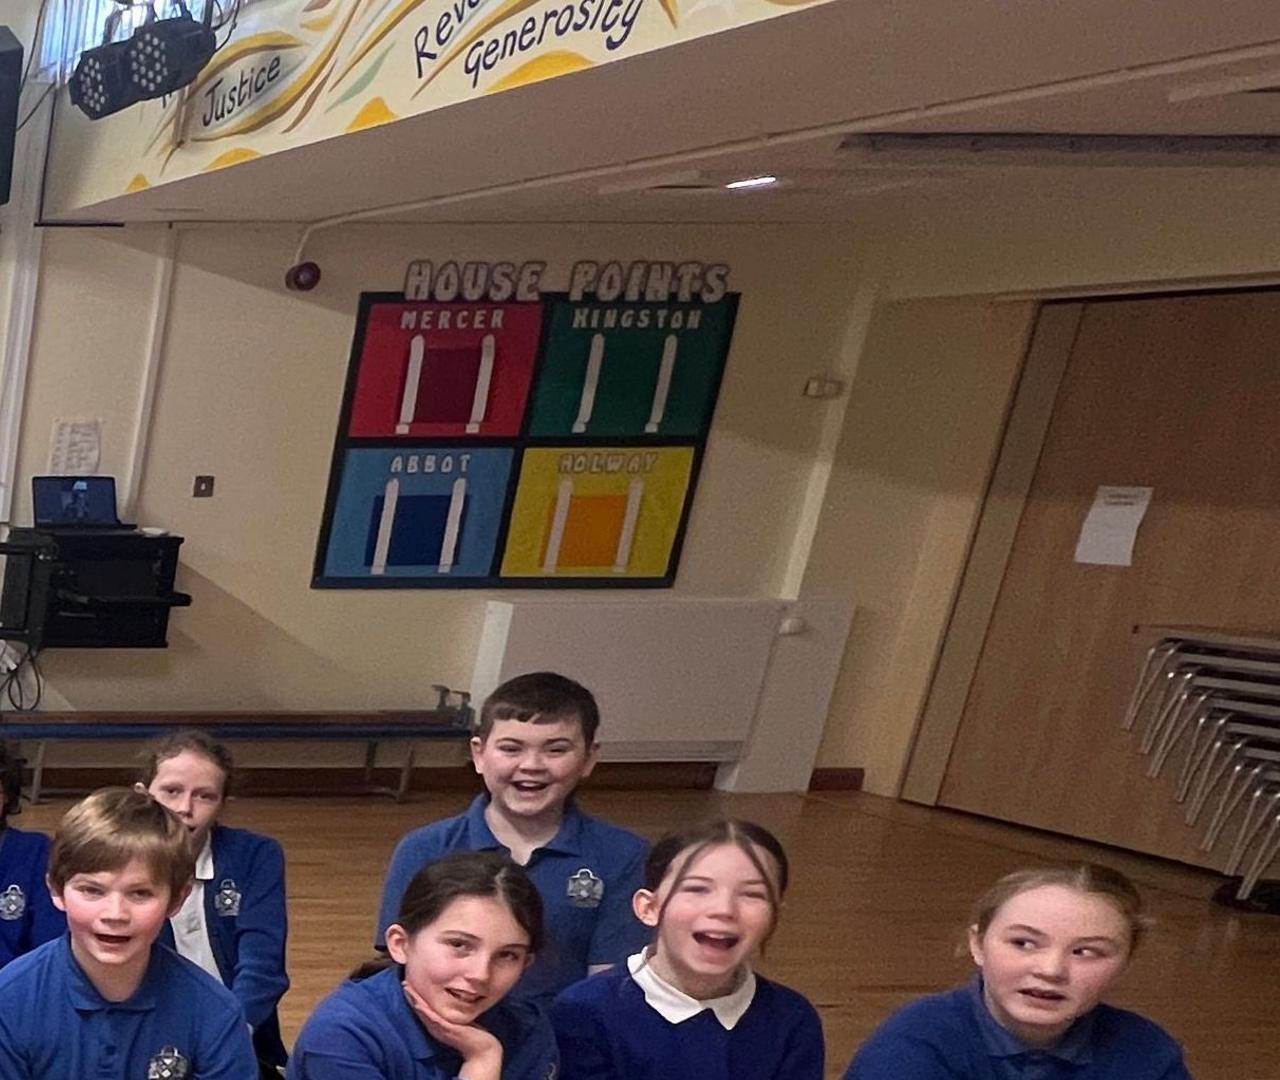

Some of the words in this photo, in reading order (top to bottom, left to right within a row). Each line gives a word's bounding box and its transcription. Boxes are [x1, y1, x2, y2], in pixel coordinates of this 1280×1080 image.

[202, 55, 281, 127] Justice
[403, 259, 546, 302] HOUSE
[569, 259, 730, 303] POINTS
[400, 309, 505, 330] MERCER
[571, 309, 703, 330] KINGSTON
[390, 454, 472, 474] ABBOT
[559, 453, 660, 475] HOLWAY
